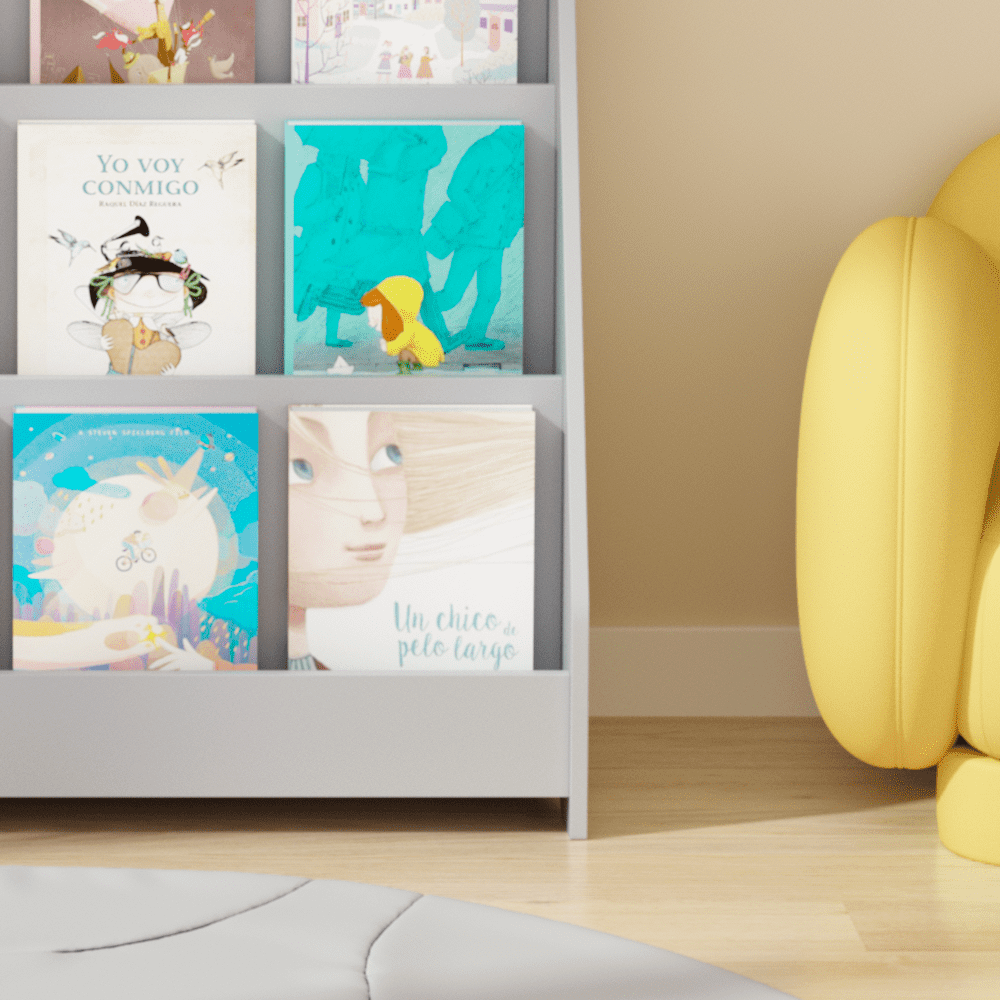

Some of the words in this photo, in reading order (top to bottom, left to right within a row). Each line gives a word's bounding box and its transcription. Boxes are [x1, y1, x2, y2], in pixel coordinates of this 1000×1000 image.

[82, 180, 200, 196] CONMIGO
[393, 600, 429, 633] Un
[436, 603, 502, 632] chico
[503, 621, 519, 637] de
[397, 632, 449, 668] pelo
[453, 634, 520, 671] largo
